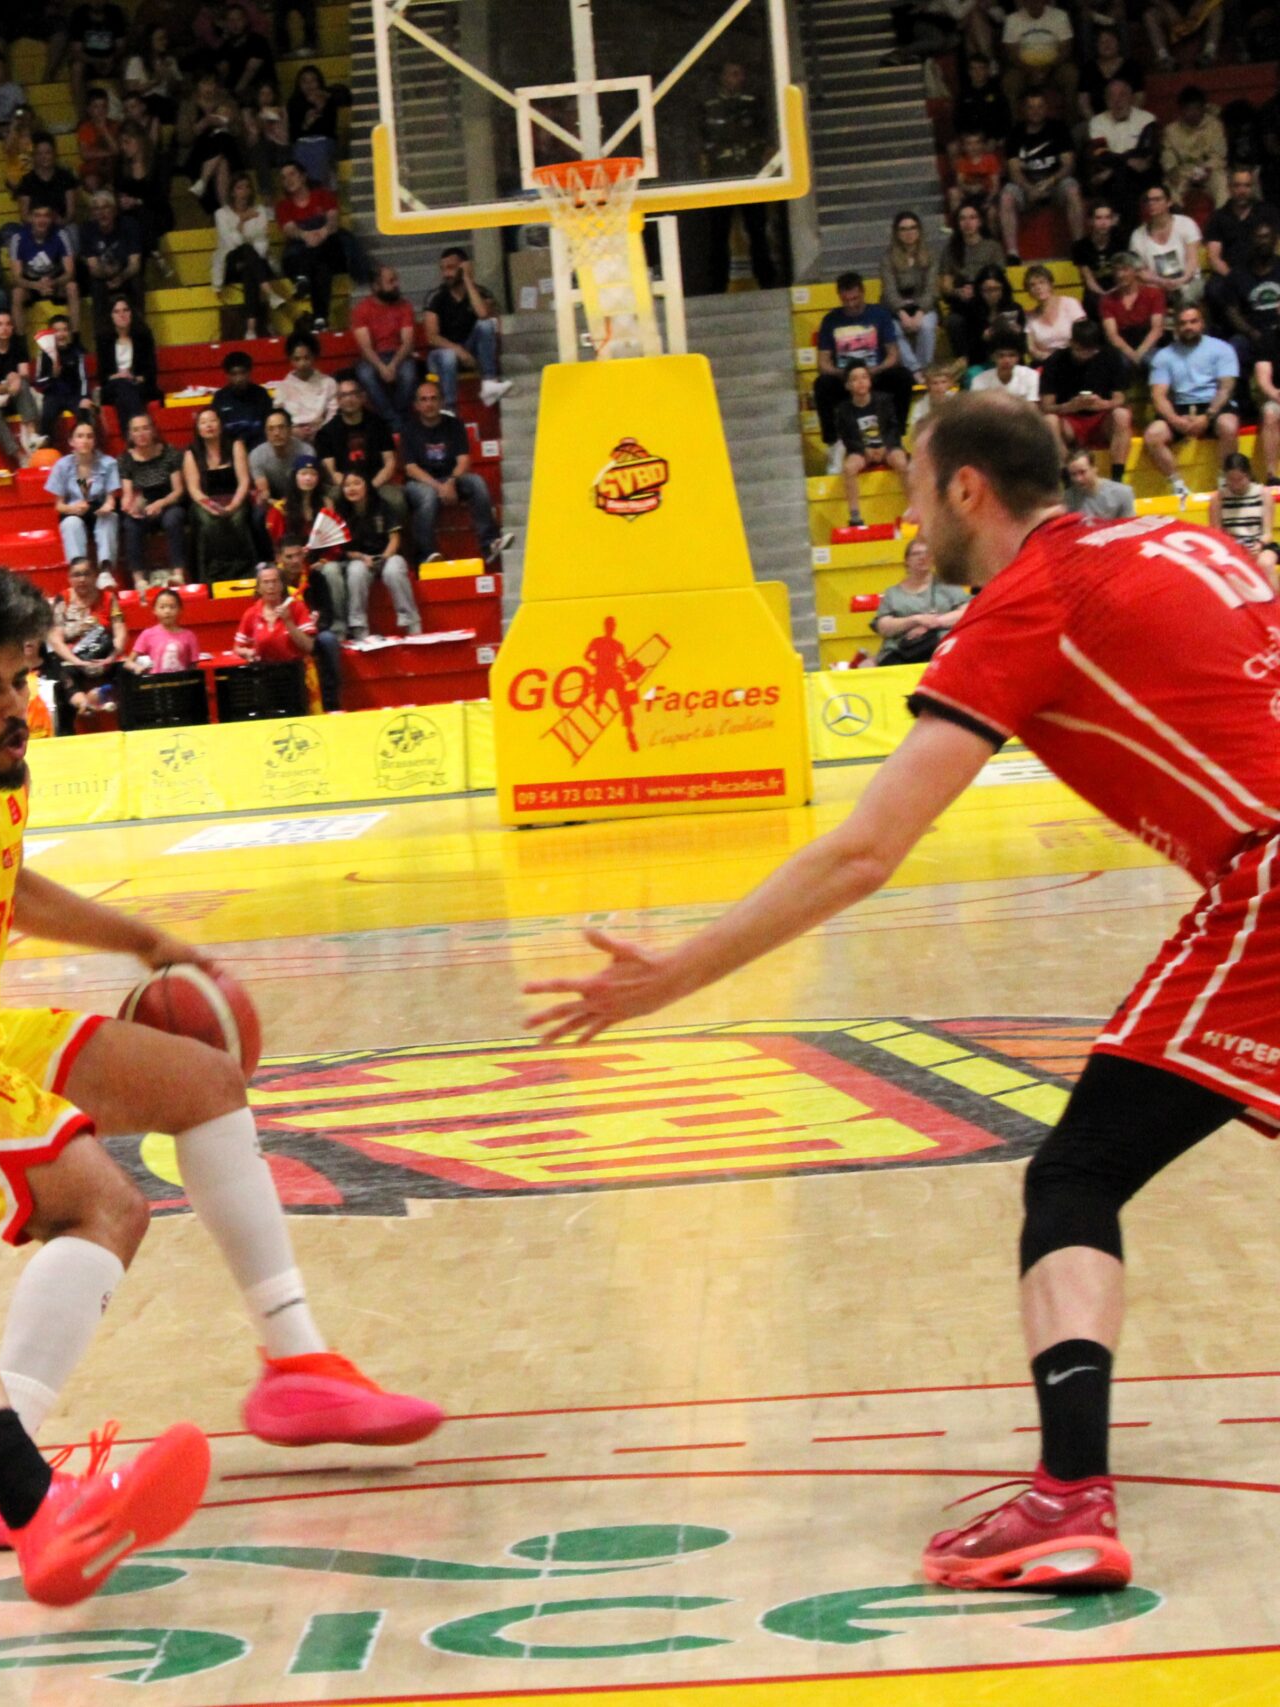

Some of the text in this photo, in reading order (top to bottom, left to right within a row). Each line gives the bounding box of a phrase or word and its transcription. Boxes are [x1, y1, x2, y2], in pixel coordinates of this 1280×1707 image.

[1139, 531, 1274, 608] 13
[508, 667, 592, 711] GO
[562, 789, 580, 802] 73
